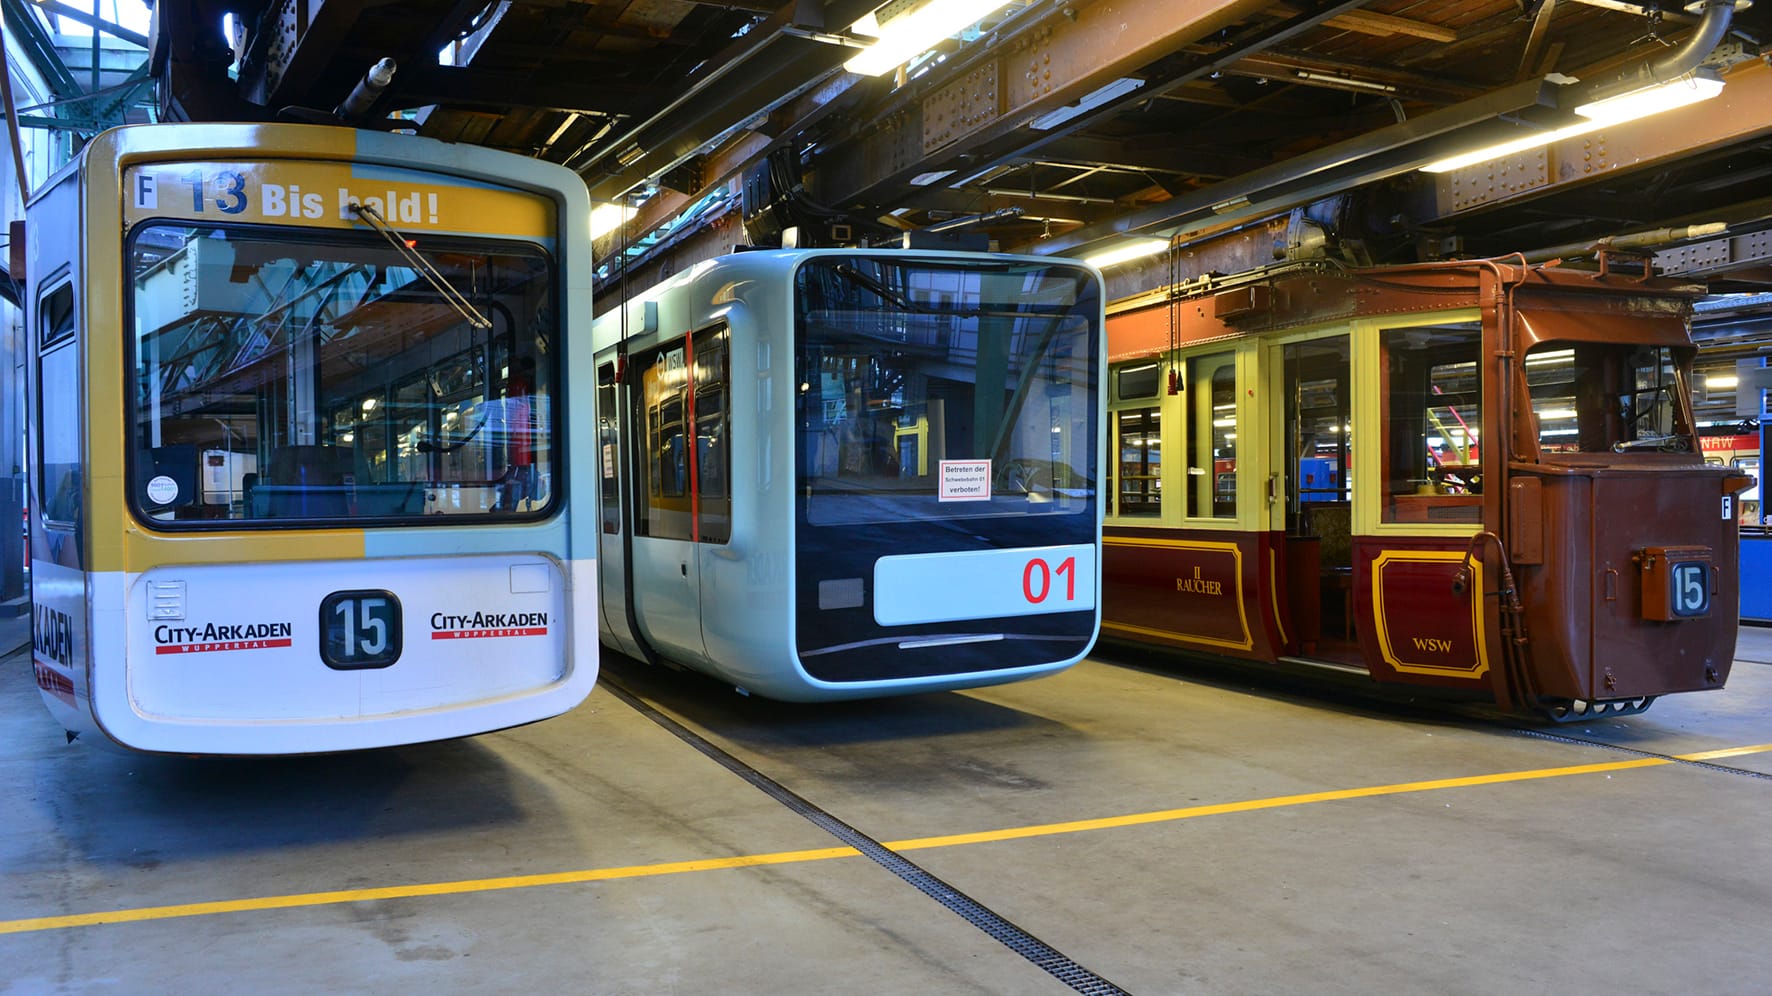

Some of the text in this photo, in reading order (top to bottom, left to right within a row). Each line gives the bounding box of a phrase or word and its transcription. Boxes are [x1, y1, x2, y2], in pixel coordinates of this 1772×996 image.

[138, 175, 153, 206] F
[180, 168, 249, 215] 13
[261, 183, 439, 224] Bis bald!
[1723, 499, 1729, 518] F
[1023, 556, 1076, 605] 01
[1176, 578, 1222, 596] RAUCHER
[1675, 566, 1704, 610] 15
[335, 598, 387, 657] 15
[453, 629, 527, 638] WUPPERTAL
[181, 640, 268, 652] WUPPERTAL
[1412, 637, 1452, 653] WSW
